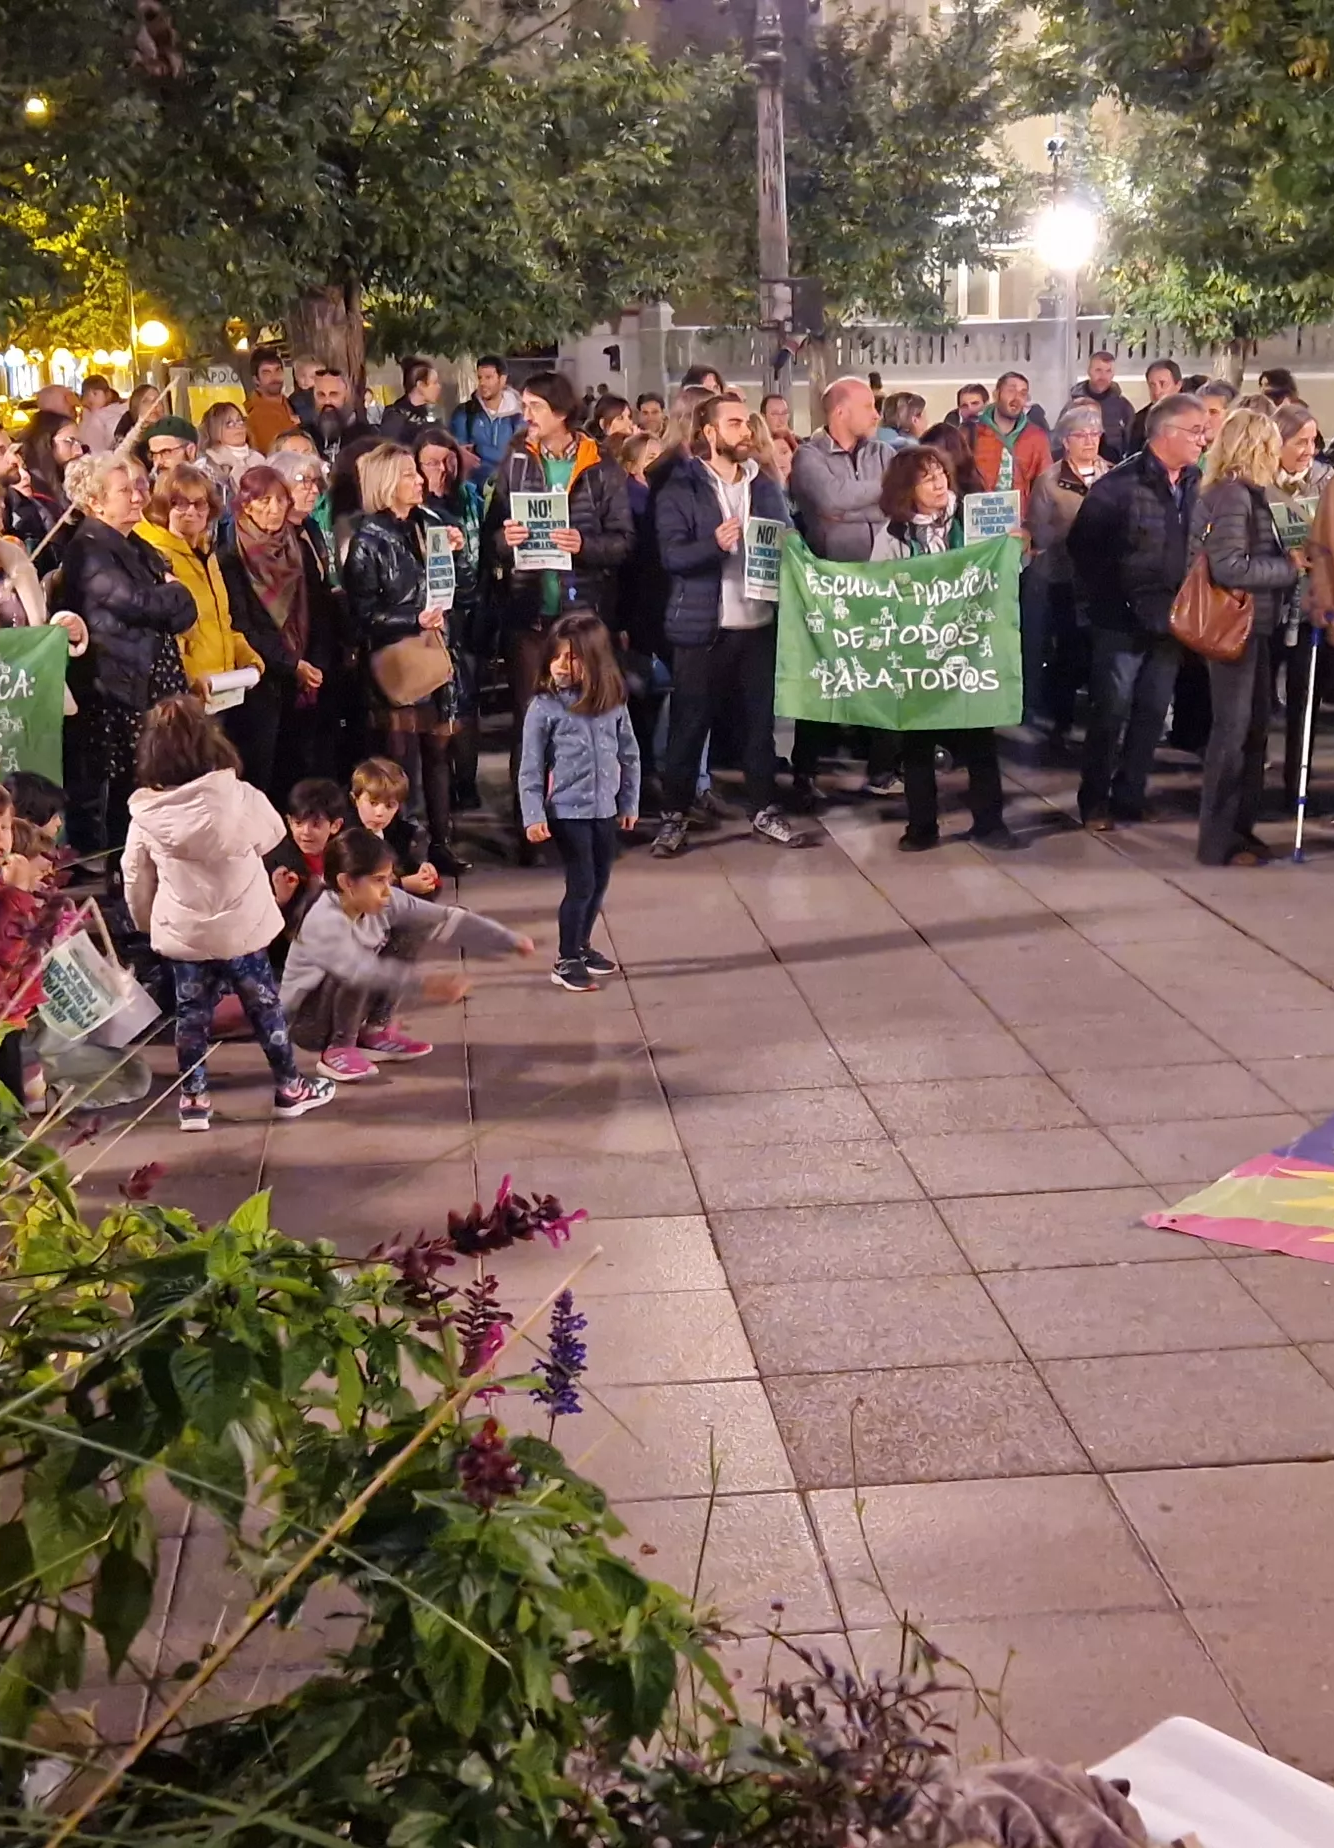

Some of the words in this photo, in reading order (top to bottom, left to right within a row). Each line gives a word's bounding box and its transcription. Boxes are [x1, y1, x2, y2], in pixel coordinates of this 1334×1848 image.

[528, 499, 552, 518] NO!
[756, 525, 778, 546] NO!
[833, 625, 865, 648] DE
[881, 622, 979, 648] TOD@S
[819, 667, 894, 693] PARA
[900, 665, 1000, 693] TOD@S
